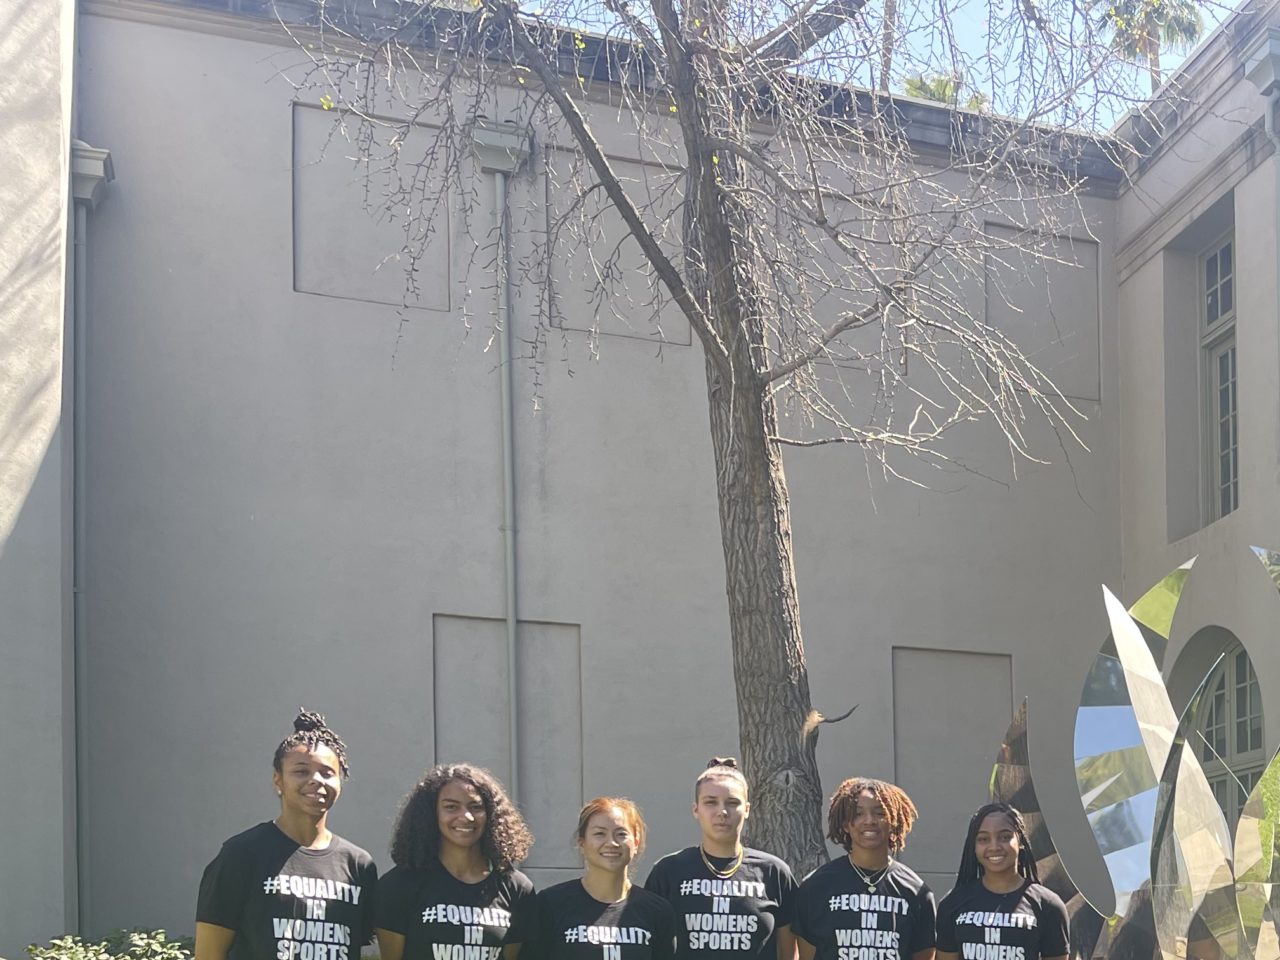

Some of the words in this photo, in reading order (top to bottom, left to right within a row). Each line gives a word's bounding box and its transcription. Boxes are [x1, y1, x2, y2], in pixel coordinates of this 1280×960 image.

[263, 874, 361, 905] #EQUALITY
[680, 879, 765, 897] #EQUALITY
[305, 900, 326, 920] IN
[712, 897, 730, 914] IN
[829, 893, 910, 916] #EQUALITY
[685, 913, 758, 933] WOMENS
[861, 912, 878, 929] IN
[956, 911, 1037, 931] #EQUALITY
[272, 918, 351, 945] WOMENS
[464, 926, 483, 945] IN
[689, 932, 751, 950] SPORTS
[835, 929, 900, 949] WOMENS
[985, 927, 1001, 944] IN
